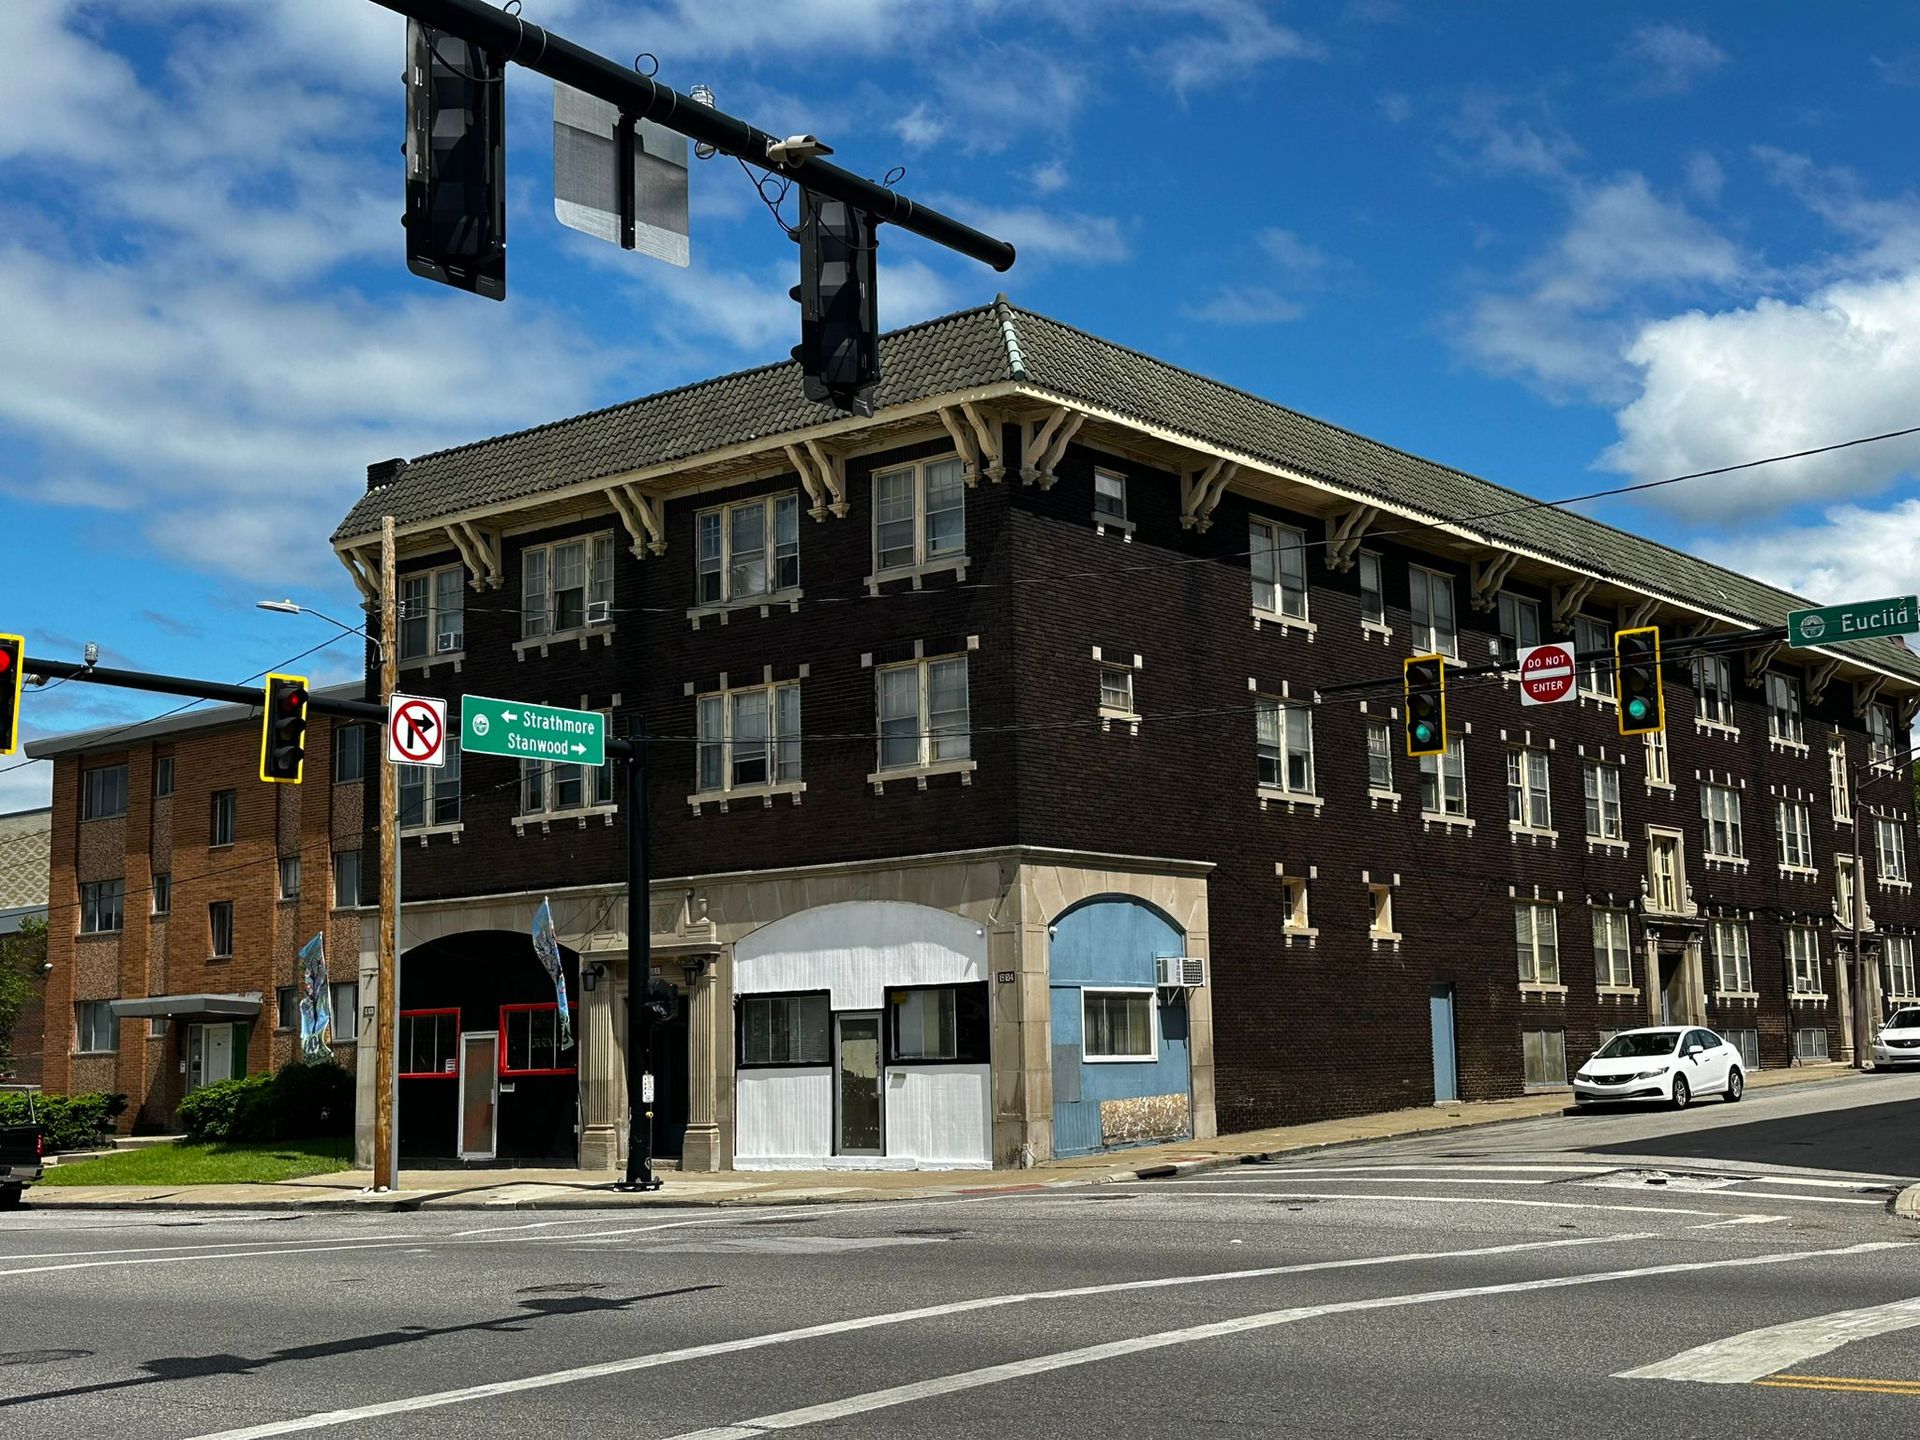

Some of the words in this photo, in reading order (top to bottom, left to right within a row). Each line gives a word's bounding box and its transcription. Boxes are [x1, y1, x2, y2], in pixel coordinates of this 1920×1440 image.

[1841, 606, 1909, 633] Euclid
[1527, 658, 1541, 669] DO
[1545, 654, 1565, 666] NOT
[1532, 680, 1564, 693] ENTER
[523, 710, 595, 735] Strathmore
[507, 732, 569, 755] Stanwood
